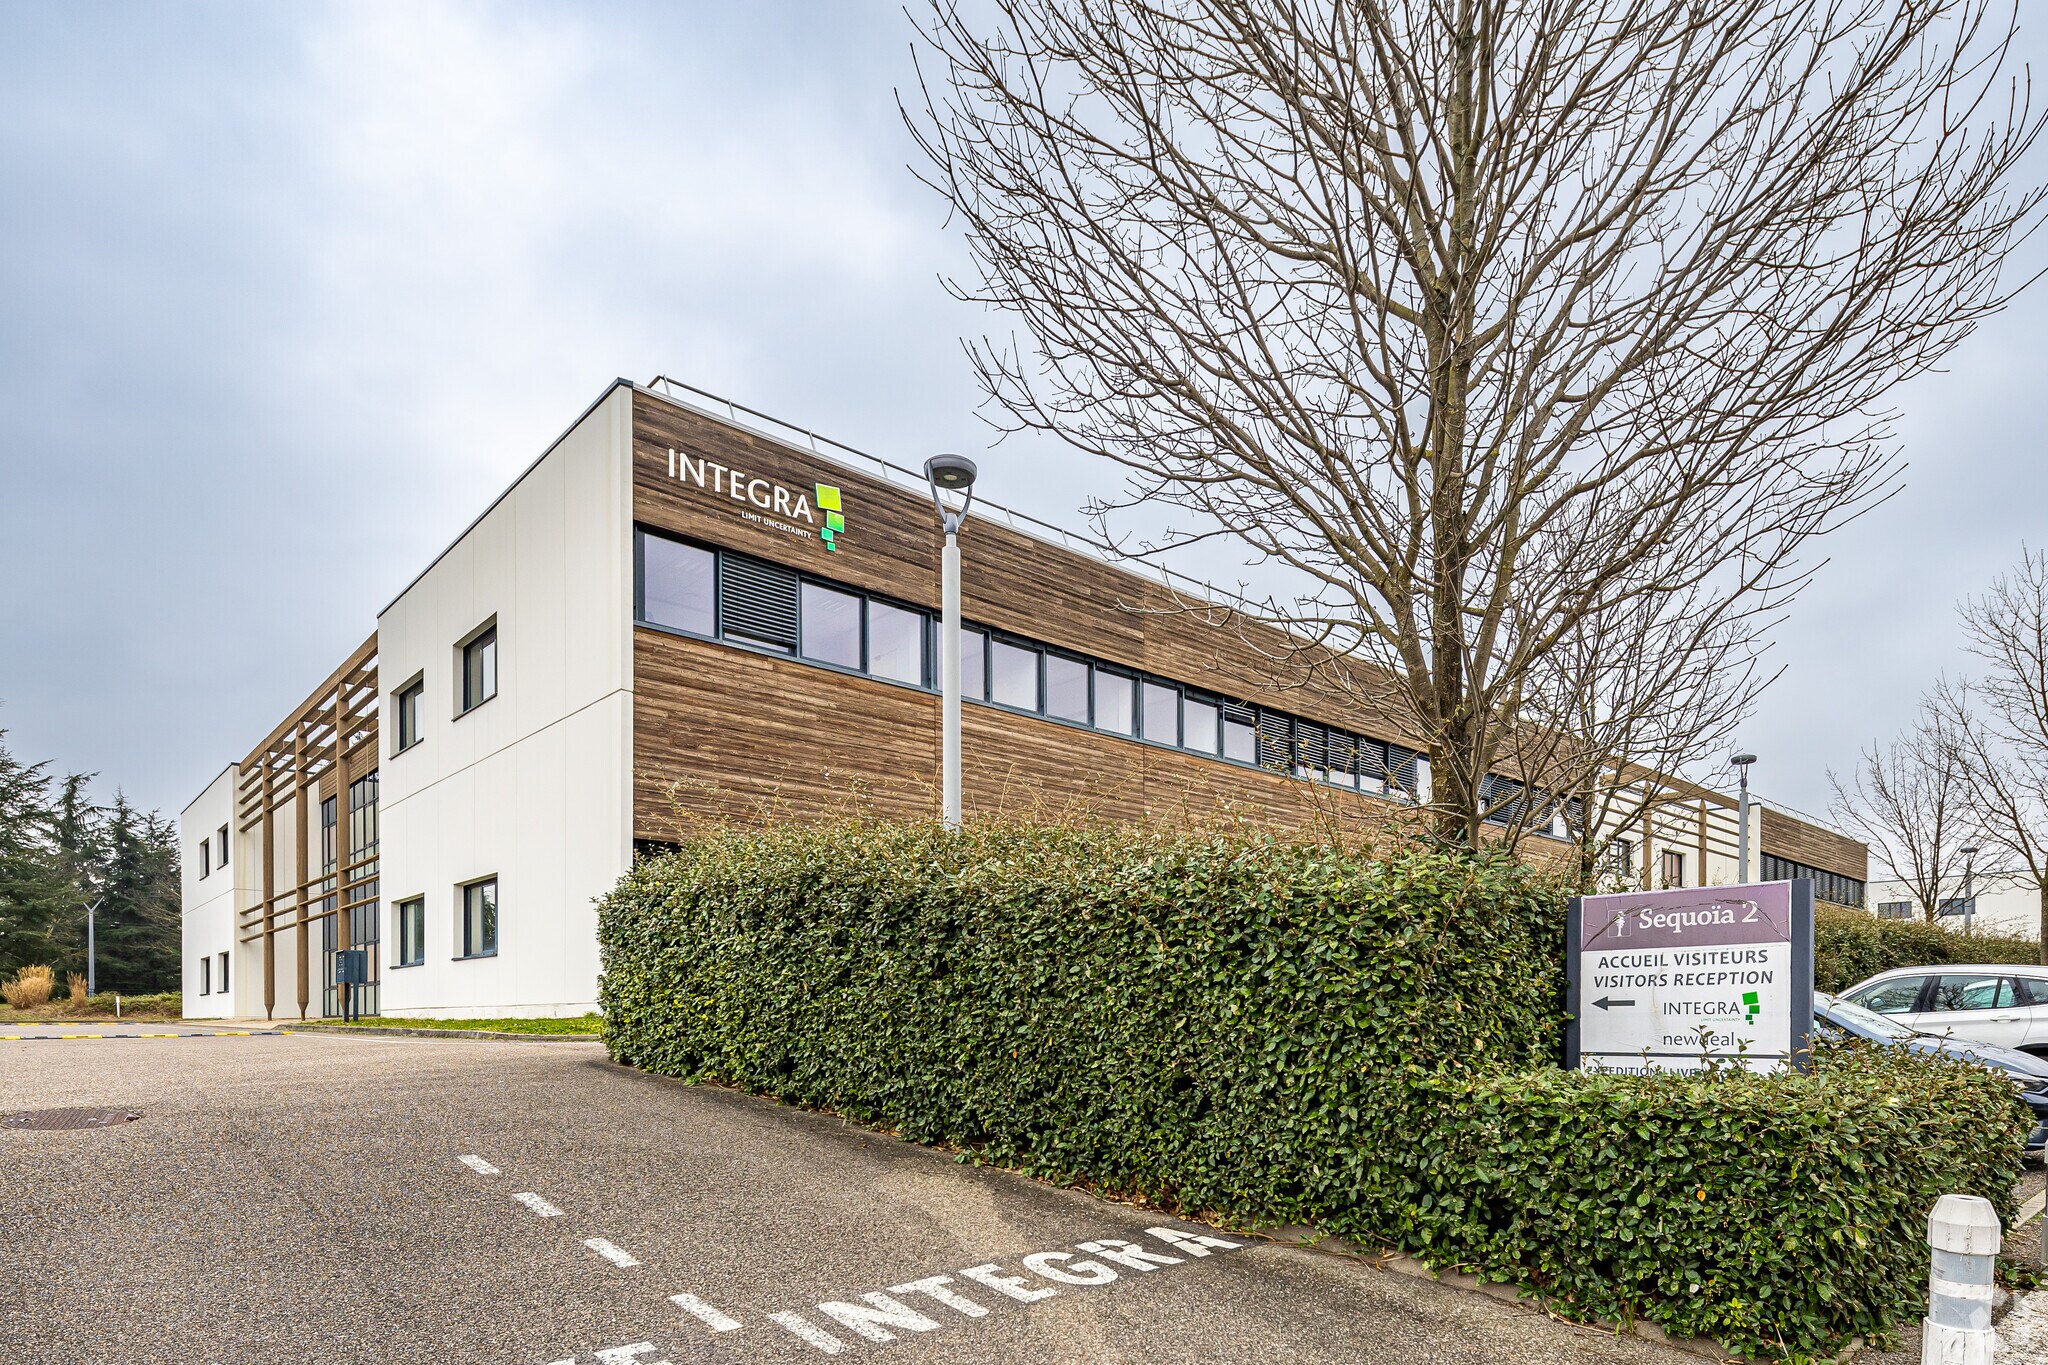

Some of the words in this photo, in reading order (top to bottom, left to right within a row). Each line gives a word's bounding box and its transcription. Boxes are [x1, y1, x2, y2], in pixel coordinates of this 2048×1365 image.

[668, 448, 814, 524] INTEGRA
[741, 511, 761, 523] LIMIT
[763, 517, 812, 539] UNCERTAINTY
[1639, 905, 1735, 933] Sequoïa
[1742, 900, 1759, 923] 2
[1598, 953, 1669, 969] ACCUEIL
[1673, 949, 1769, 967] VISITEURS
[1593, 973, 1668, 988] VISITORS
[1673, 970, 1773, 987] RECEPTION
[1663, 1001, 1740, 1015] INTEGRA
[768, 1226, 1244, 1356] INTEGRA
